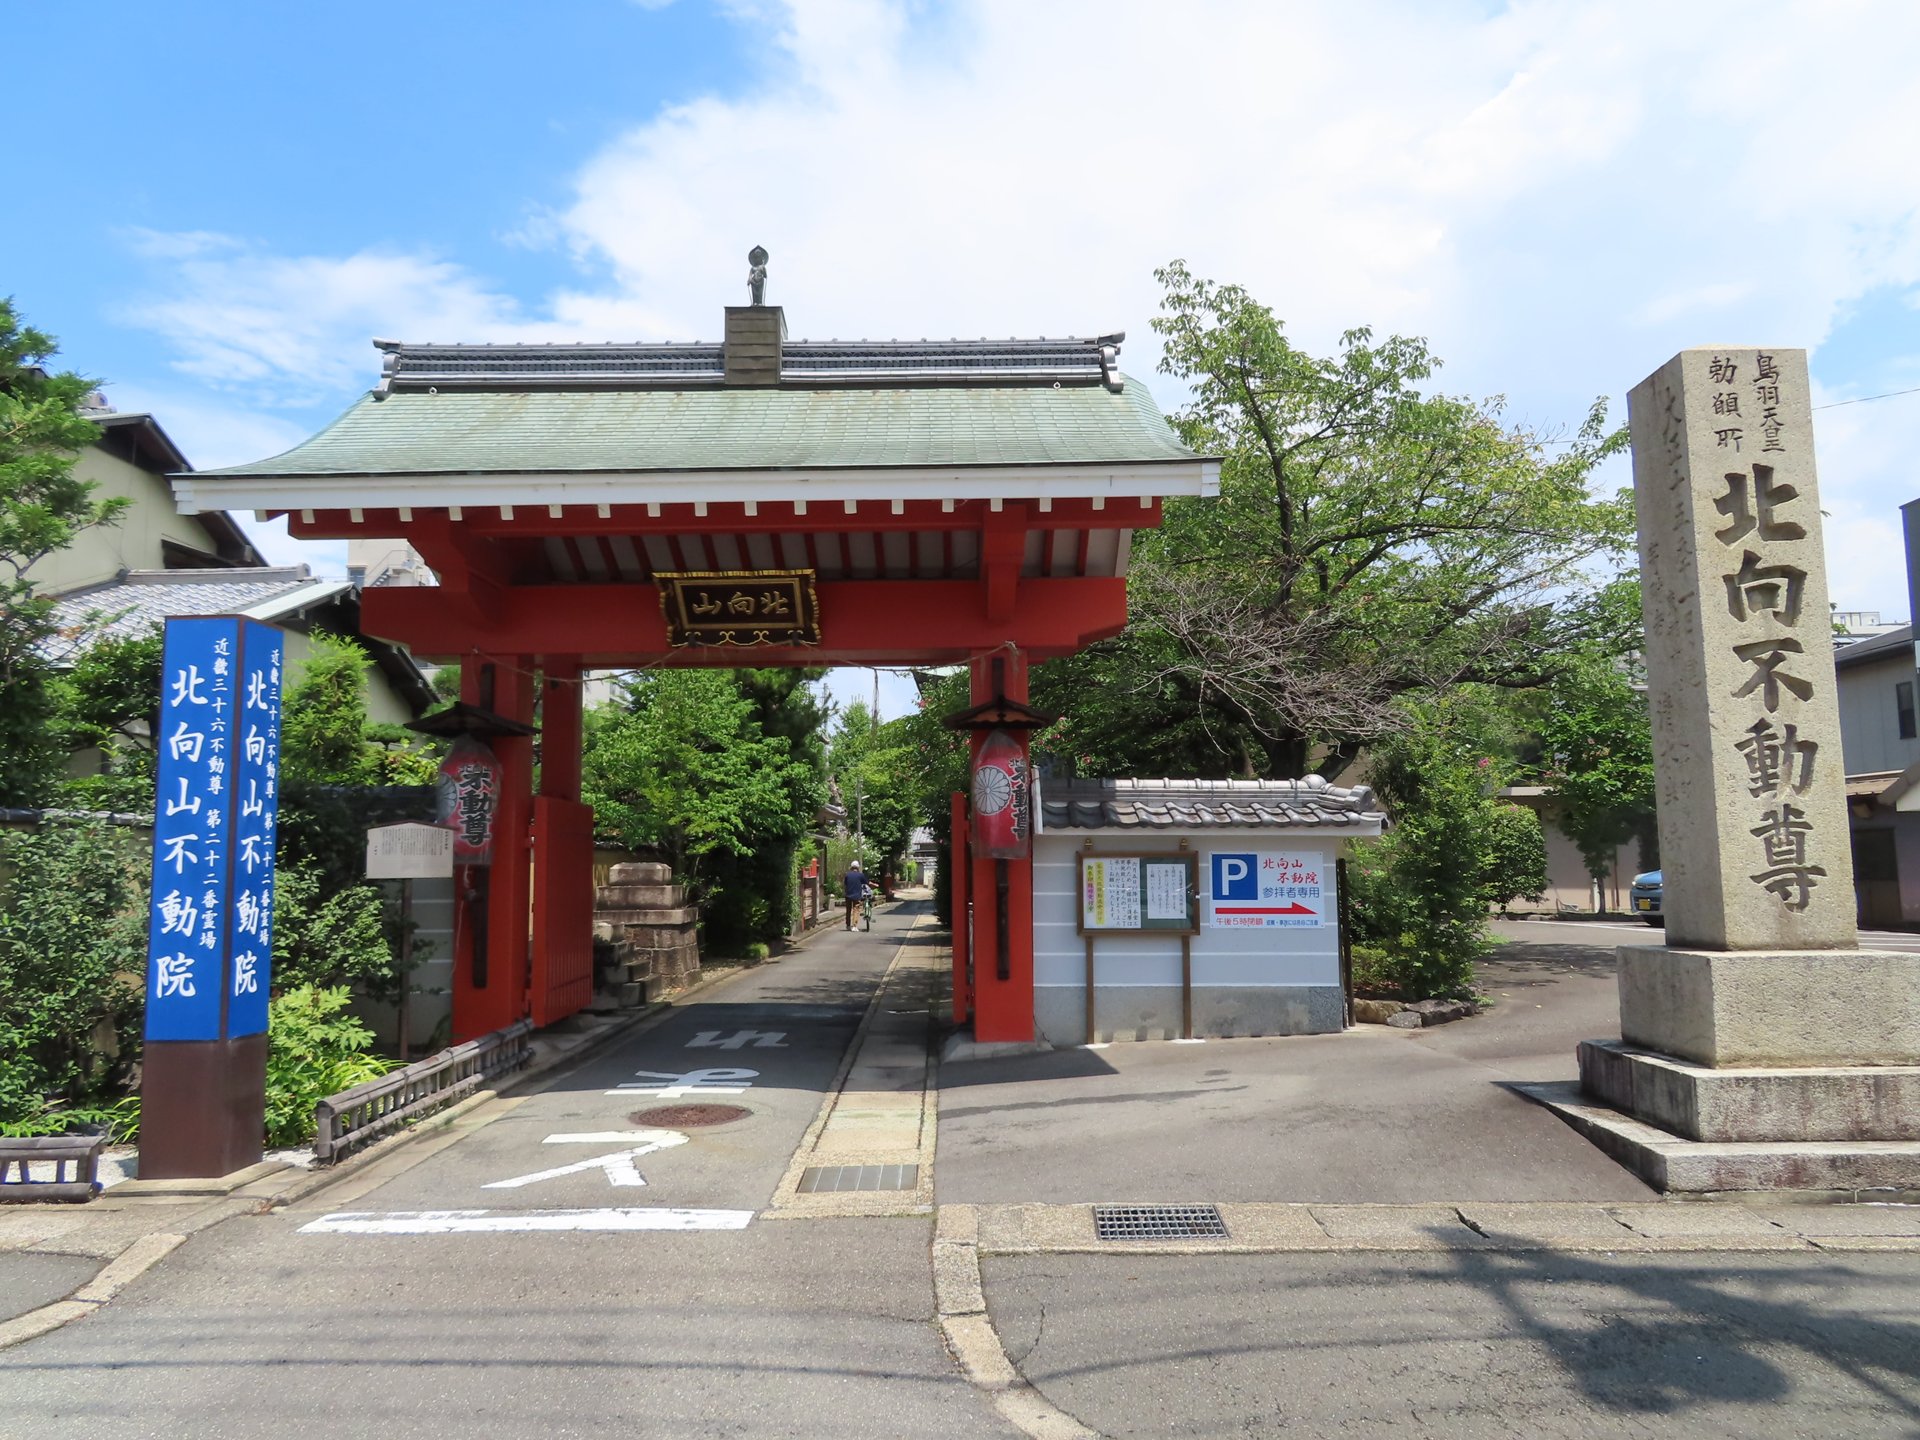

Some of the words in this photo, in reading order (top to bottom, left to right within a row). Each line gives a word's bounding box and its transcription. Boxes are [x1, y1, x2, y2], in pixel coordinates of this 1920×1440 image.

[693, 590, 789, 615] 北向山
[207, 637, 231, 795] 近畿三十六不動尊
[264, 648, 280, 799] 近畿三十六不動尊
[1713, 463, 1827, 913] 北向不動尊
[156, 664, 209, 999] 北向山不動院
[234, 669, 269, 997] 北向山不動院
[458, 771, 494, 846] 不動尊
[1263, 857, 1304, 870] 北向山
[199, 808, 222, 950] 第二十二番霊場
[258, 812, 274, 947] 第二十二番霊場
[1221, 858, 1248, 896] P
[1262, 886, 1320, 899] 参拝者専用
[1276, 871, 1319, 885] 不動院
